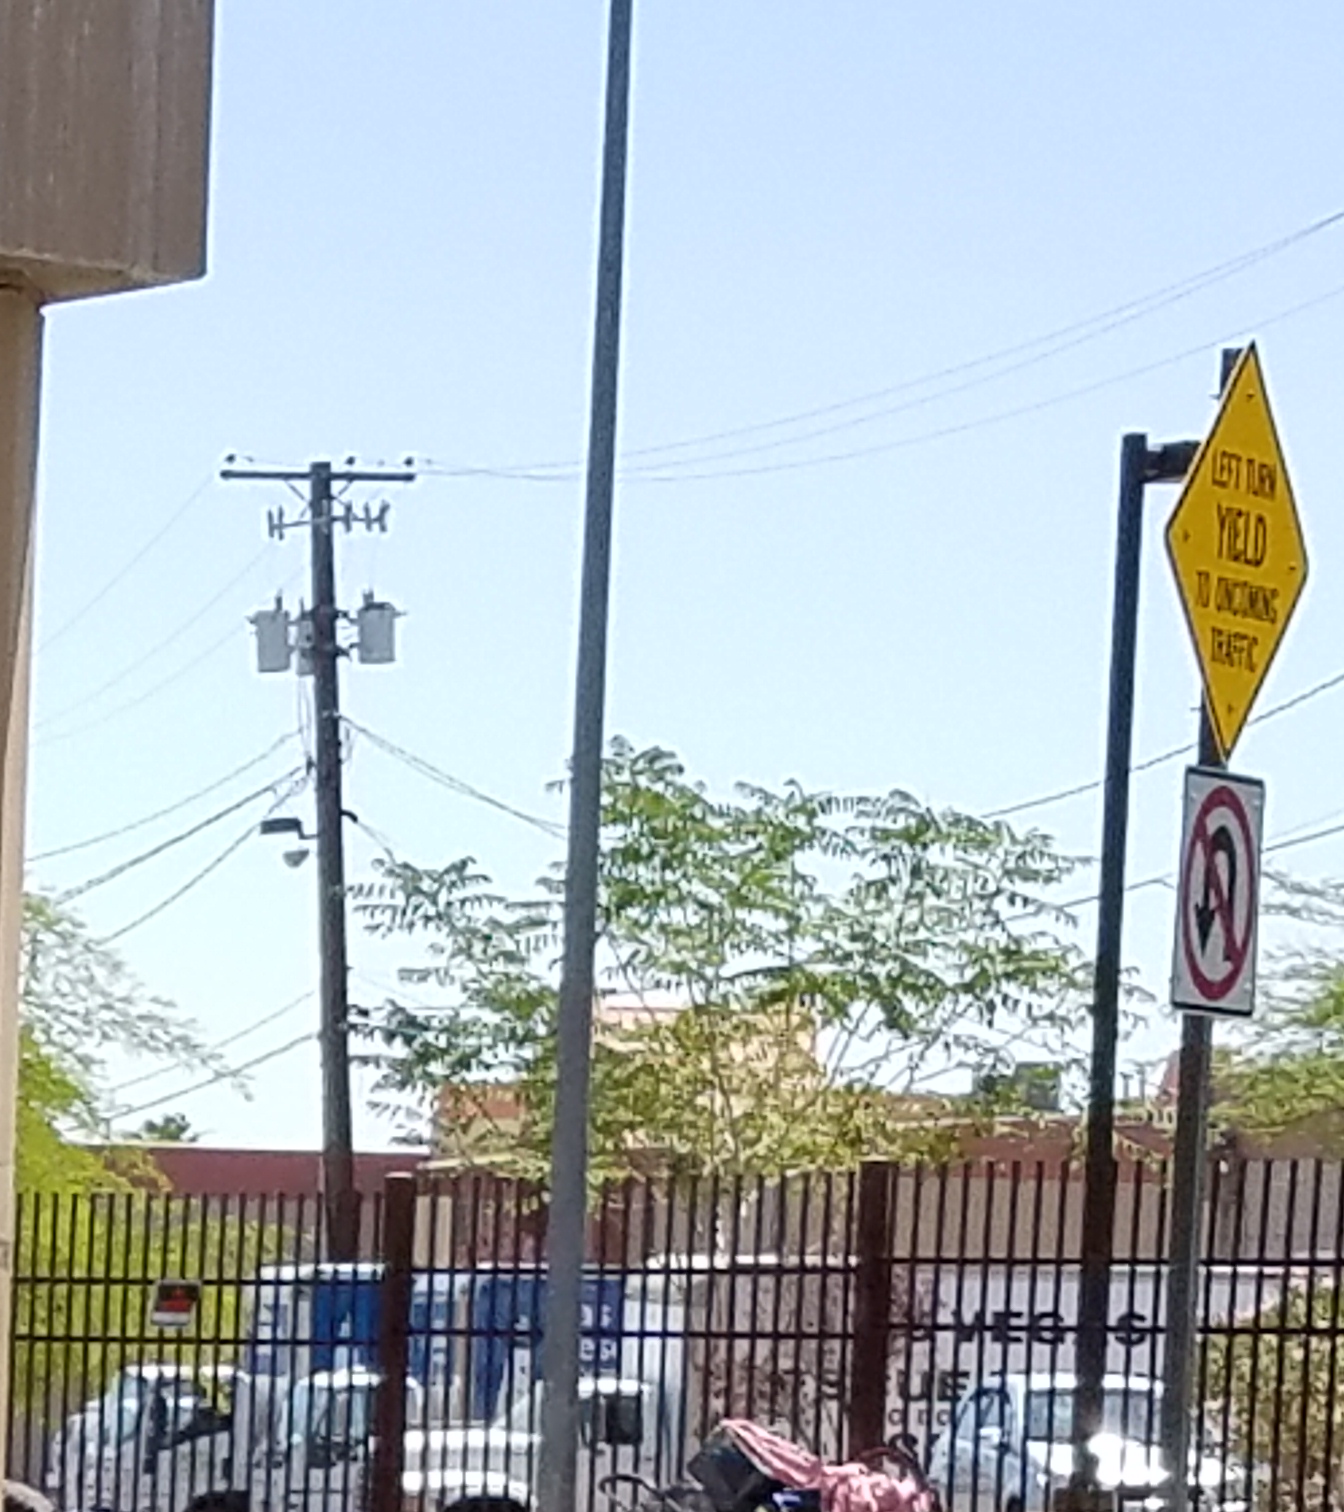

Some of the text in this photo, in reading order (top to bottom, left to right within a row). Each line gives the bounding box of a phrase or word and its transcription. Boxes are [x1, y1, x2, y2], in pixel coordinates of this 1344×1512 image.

[1211, 448, 1277, 501] LEFT TURN
[1216, 502, 1267, 568] YIELD
[1195, 569, 1211, 608] TO
[1211, 626, 1259, 673] TRAFFIC
